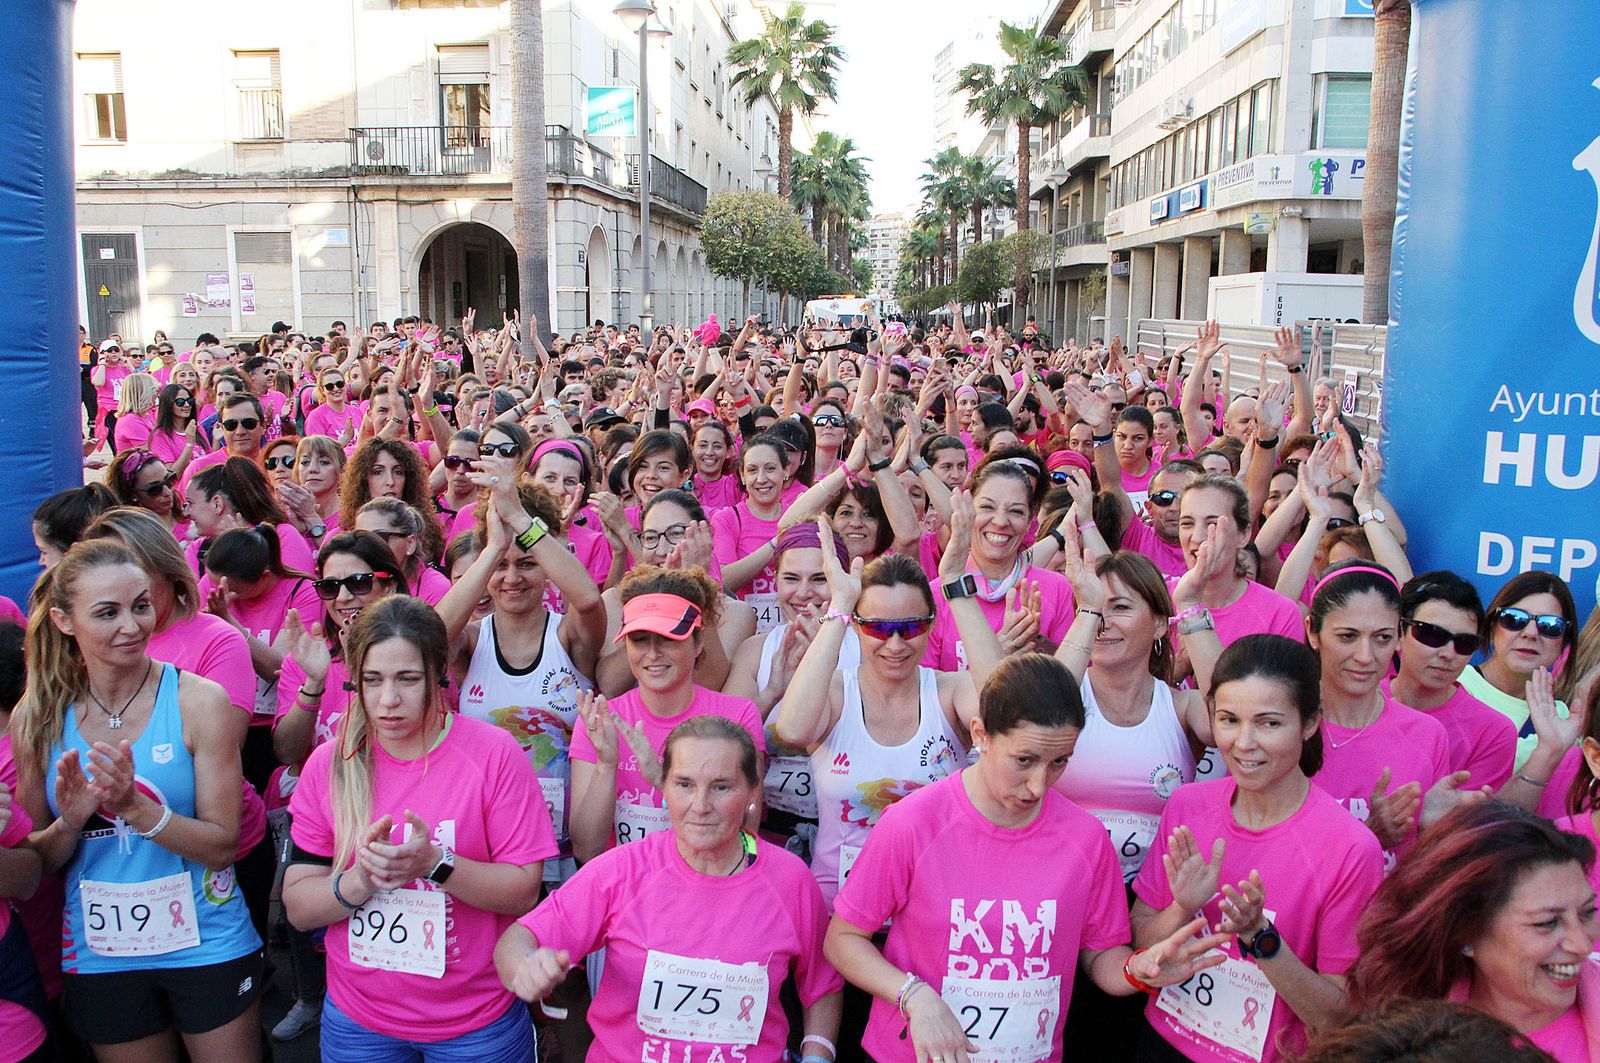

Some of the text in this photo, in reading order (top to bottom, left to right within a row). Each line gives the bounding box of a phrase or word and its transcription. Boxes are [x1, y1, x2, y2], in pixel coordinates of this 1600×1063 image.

[1217, 161, 1255, 188] PREVENTIVA
[1258, 179, 1293, 187] PREVENTIVA
[1483, 430, 1600, 490] HU
[778, 771, 811, 797] 73
[628, 810, 658, 822] Carrera
[1097, 815, 1124, 824] arrera
[1127, 816, 1138, 825] de
[1140, 817, 1149, 826] la
[132, 890, 145, 898] de
[159, 881, 185, 895] Mujer
[392, 896, 403, 905] de
[406, 897, 414, 907] la
[416, 898, 441, 910] Mujer
[89, 903, 151, 932] 519
[352, 907, 408, 944] 596
[949, 898, 1057, 955] KM
[667, 963, 708, 978] Carrera
[710, 970, 723, 980] de
[725, 972, 735, 983] la
[737, 974, 765, 987] Mujer
[1215, 963, 1270, 990] de la Mujer
[653, 980, 722, 1014] 175
[964, 986, 1005, 998] Carrera
[1007, 987, 1019, 998] de
[1022, 988, 1031, 998] la
[960, 1005, 1009, 1040] 27
